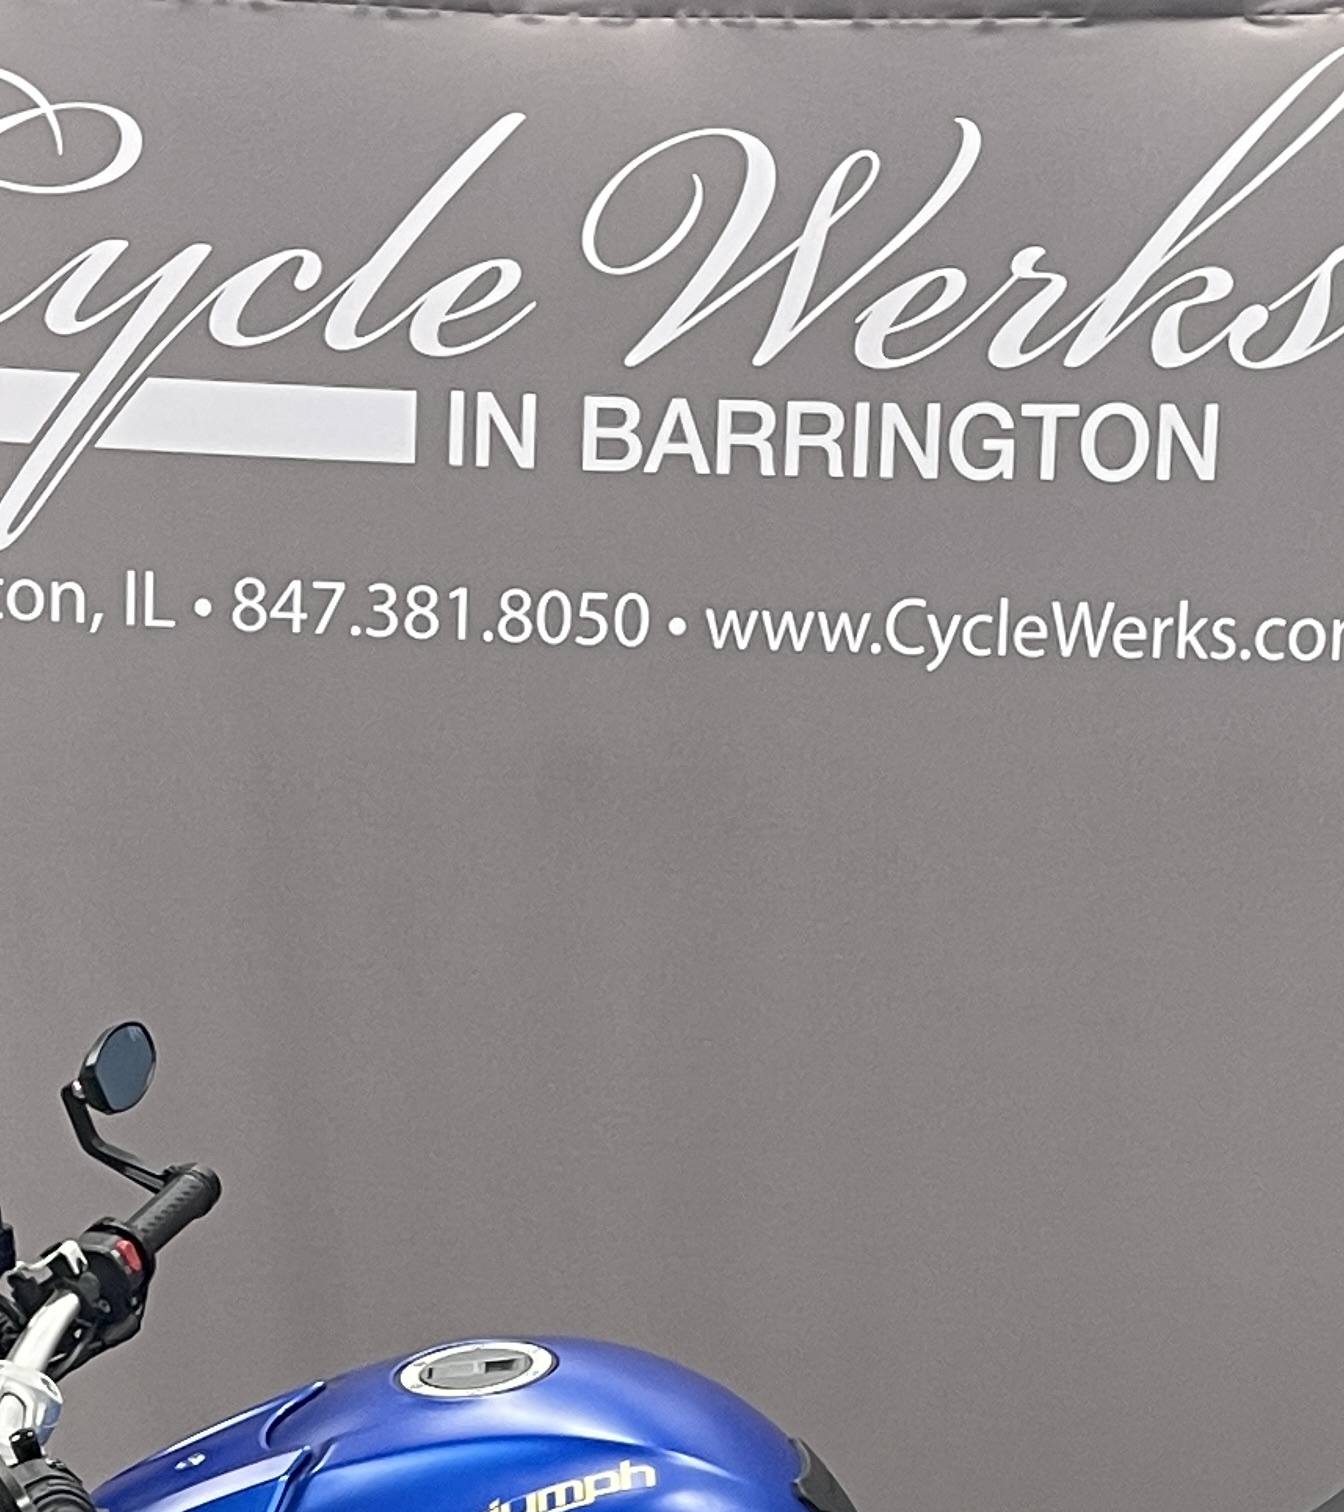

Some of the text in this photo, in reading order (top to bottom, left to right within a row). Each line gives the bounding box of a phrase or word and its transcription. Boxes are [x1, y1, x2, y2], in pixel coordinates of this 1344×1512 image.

[448, 390, 1219, 483] IN BARRINGTON
[126, 570, 176, 628] IL
[232, 576, 650, 647] 847.381.8050
